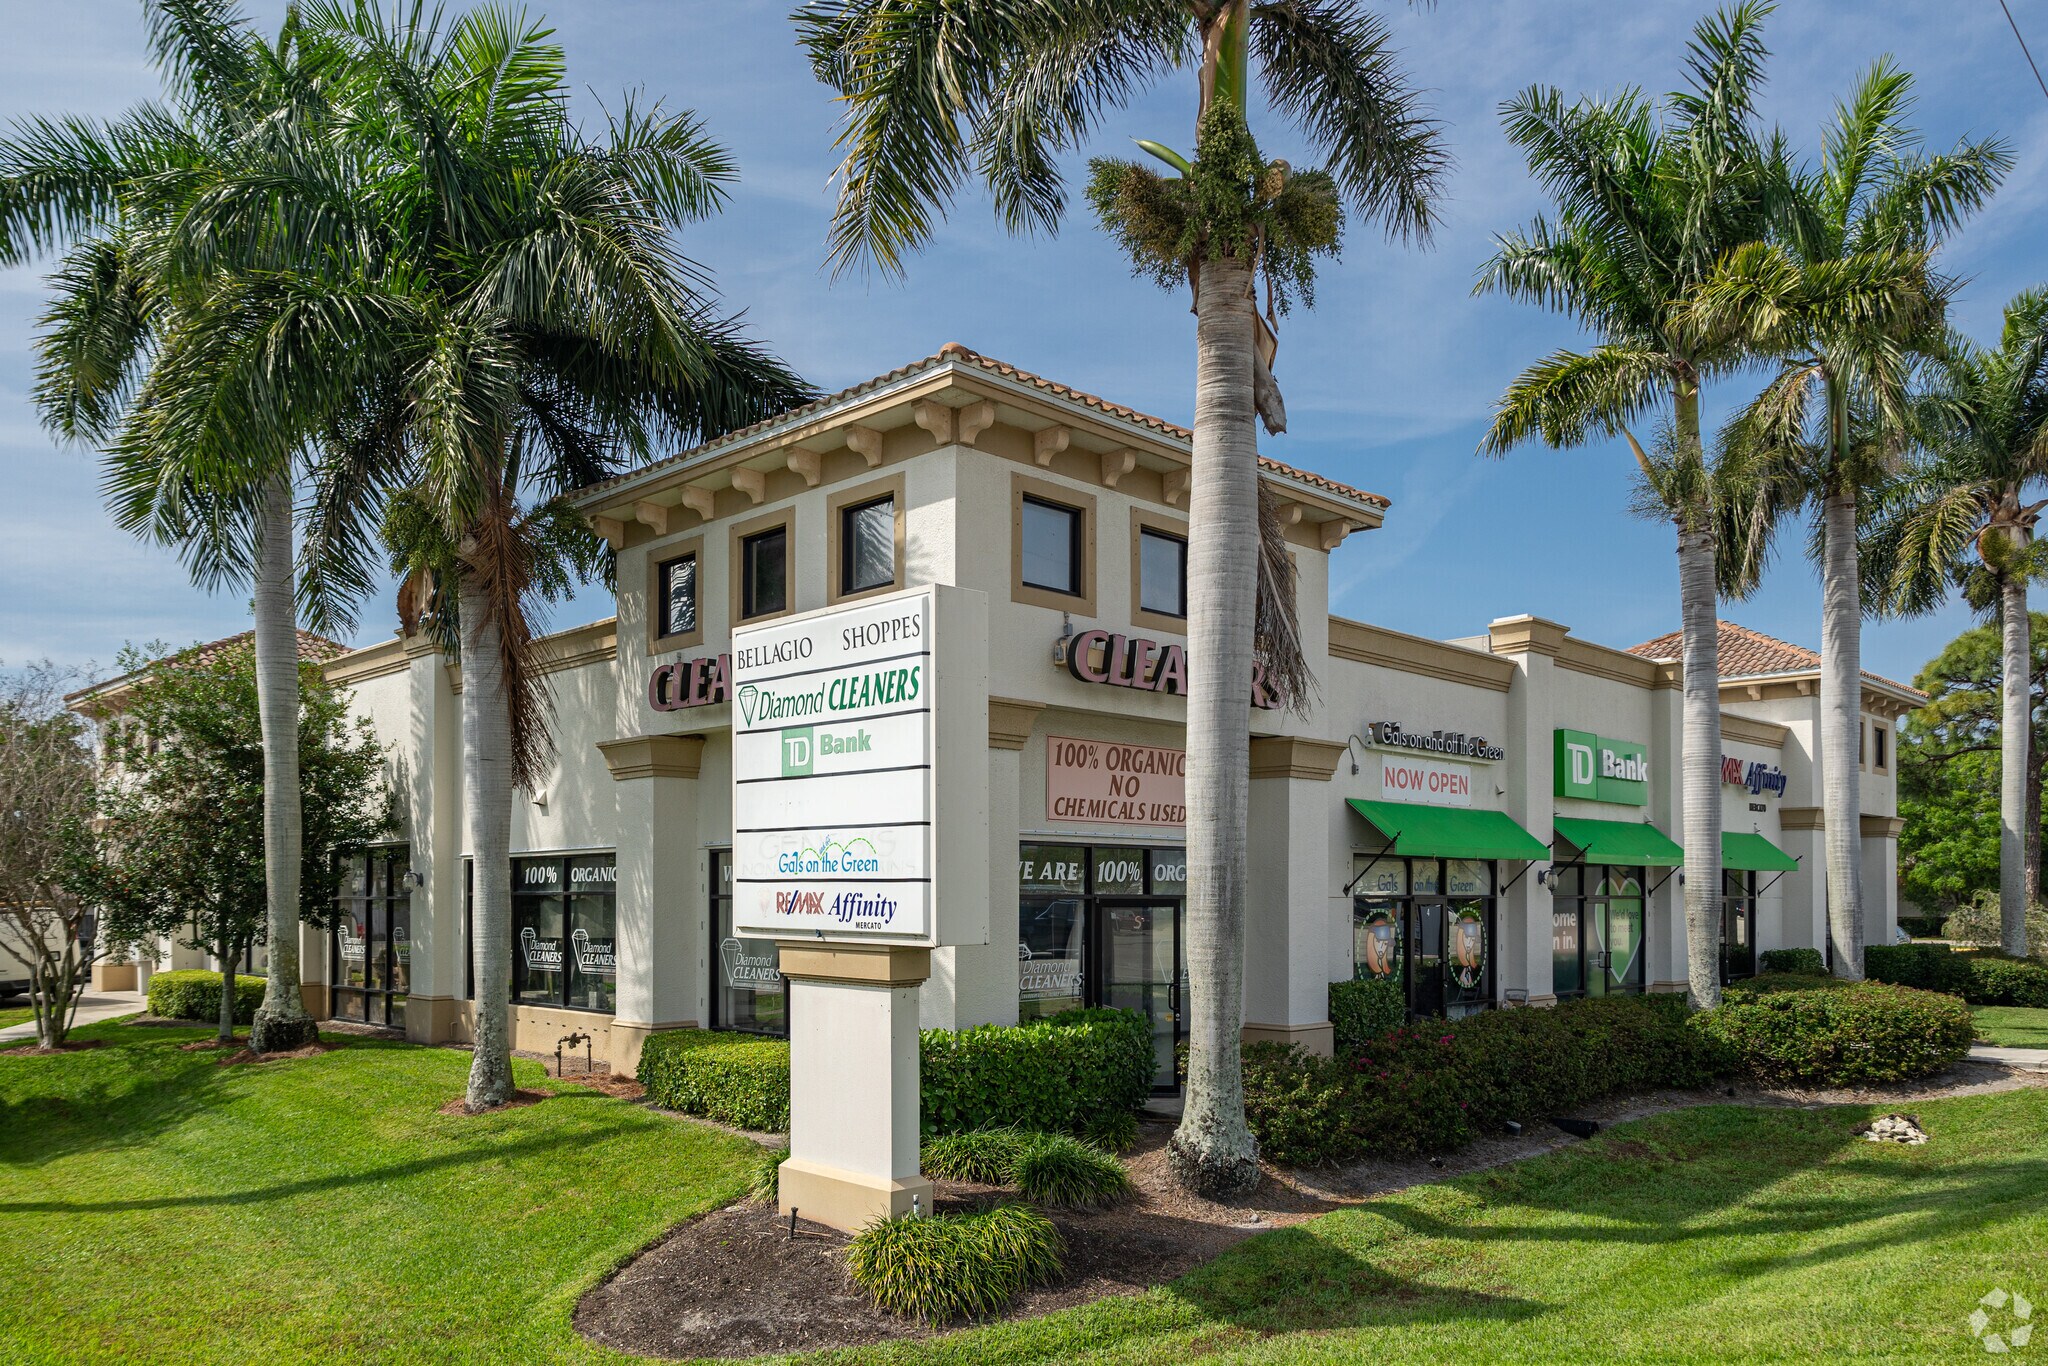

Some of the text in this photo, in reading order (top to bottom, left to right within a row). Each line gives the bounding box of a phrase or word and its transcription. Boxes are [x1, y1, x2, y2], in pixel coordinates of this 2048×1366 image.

[737, 613, 921, 670] BELLAGIO SHOPPES
[758, 665, 921, 721] Diamond CLEANERS
[785, 728, 872, 767] TD Bank
[1381, 721, 1408, 747] Gals
[1409, 734, 1423, 749] on
[1425, 731, 1444, 752] and
[1460, 734, 1473, 756] the
[1475, 736, 1506, 760] Green
[1055, 741, 1187, 777] 100% ORGANIC
[1566, 742, 1648, 785] TD Bank
[1108, 774, 1141, 798] NO
[1384, 766, 1469, 796] NOW OPEN
[1744, 761, 1787, 798] Affinity
[1054, 797, 1187, 823] CHEMICALS USED
[524, 865, 557, 884] 100%
[778, 851, 805, 875] Gals
[806, 859, 819, 873] on
[821, 852, 838, 873] the
[841, 851, 879, 872] Green
[1039, 862, 1079, 881] ARE
[1097, 860, 1141, 883] 100%
[1377, 872, 1399, 893] Gals
[1450, 875, 1475, 892] Green
[776, 889, 898, 924] RE/MAX Affinity
[855, 921, 882, 930] MERCATO
[1553, 912, 1577, 927] ome
[529, 950, 563, 963] CLEANERS
[531, 940, 557, 951] Diamond
[583, 942, 612, 953] Diamond
[582, 953, 617, 967] CLEANERS
[735, 952, 773, 967] Diamond
[1022, 958, 1072, 975] Diamond
[733, 966, 781, 981] CLEANERS
[1019, 972, 1083, 990] CLEANERS
